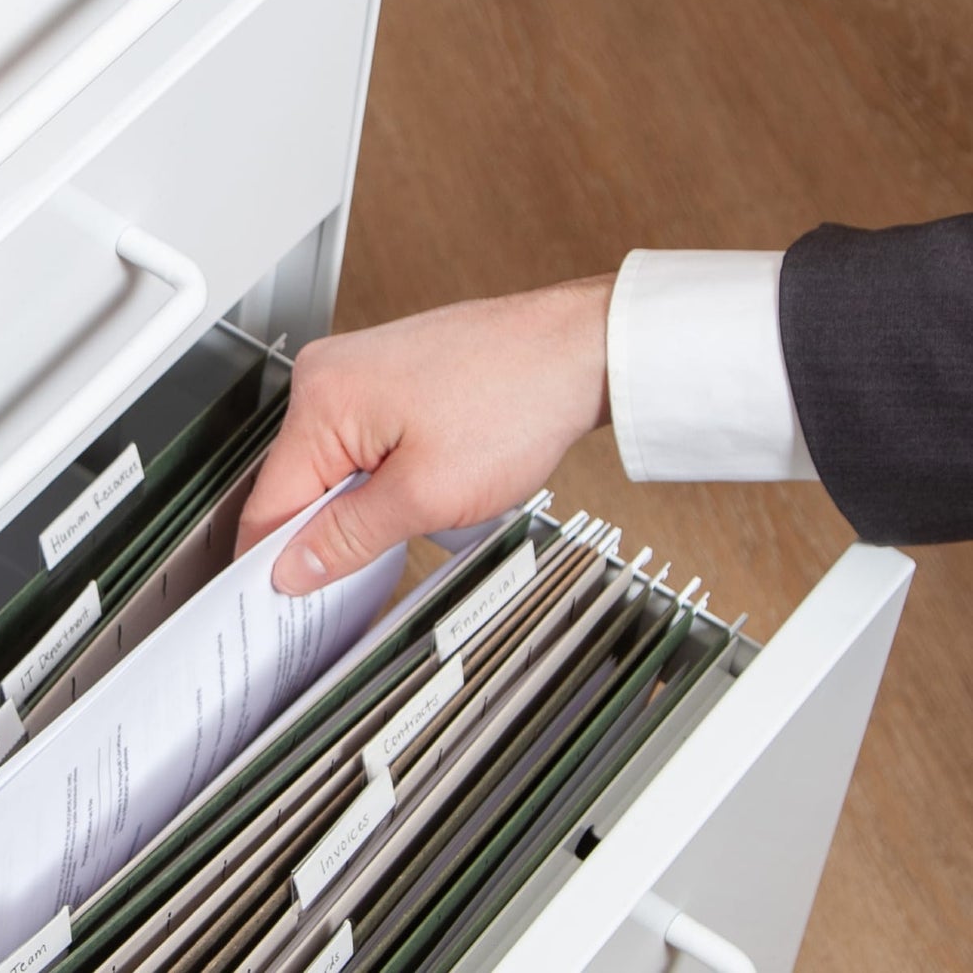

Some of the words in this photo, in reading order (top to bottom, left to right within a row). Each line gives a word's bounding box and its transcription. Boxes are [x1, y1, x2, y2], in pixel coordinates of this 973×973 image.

[50, 510, 91, 555] Human
[450, 570, 516, 639] Financial
[20, 665, 34, 691] IT
[383, 693, 439, 754] Contracts
[319, 813, 370, 875] Invoices
[9, 943, 47, 973] Team
